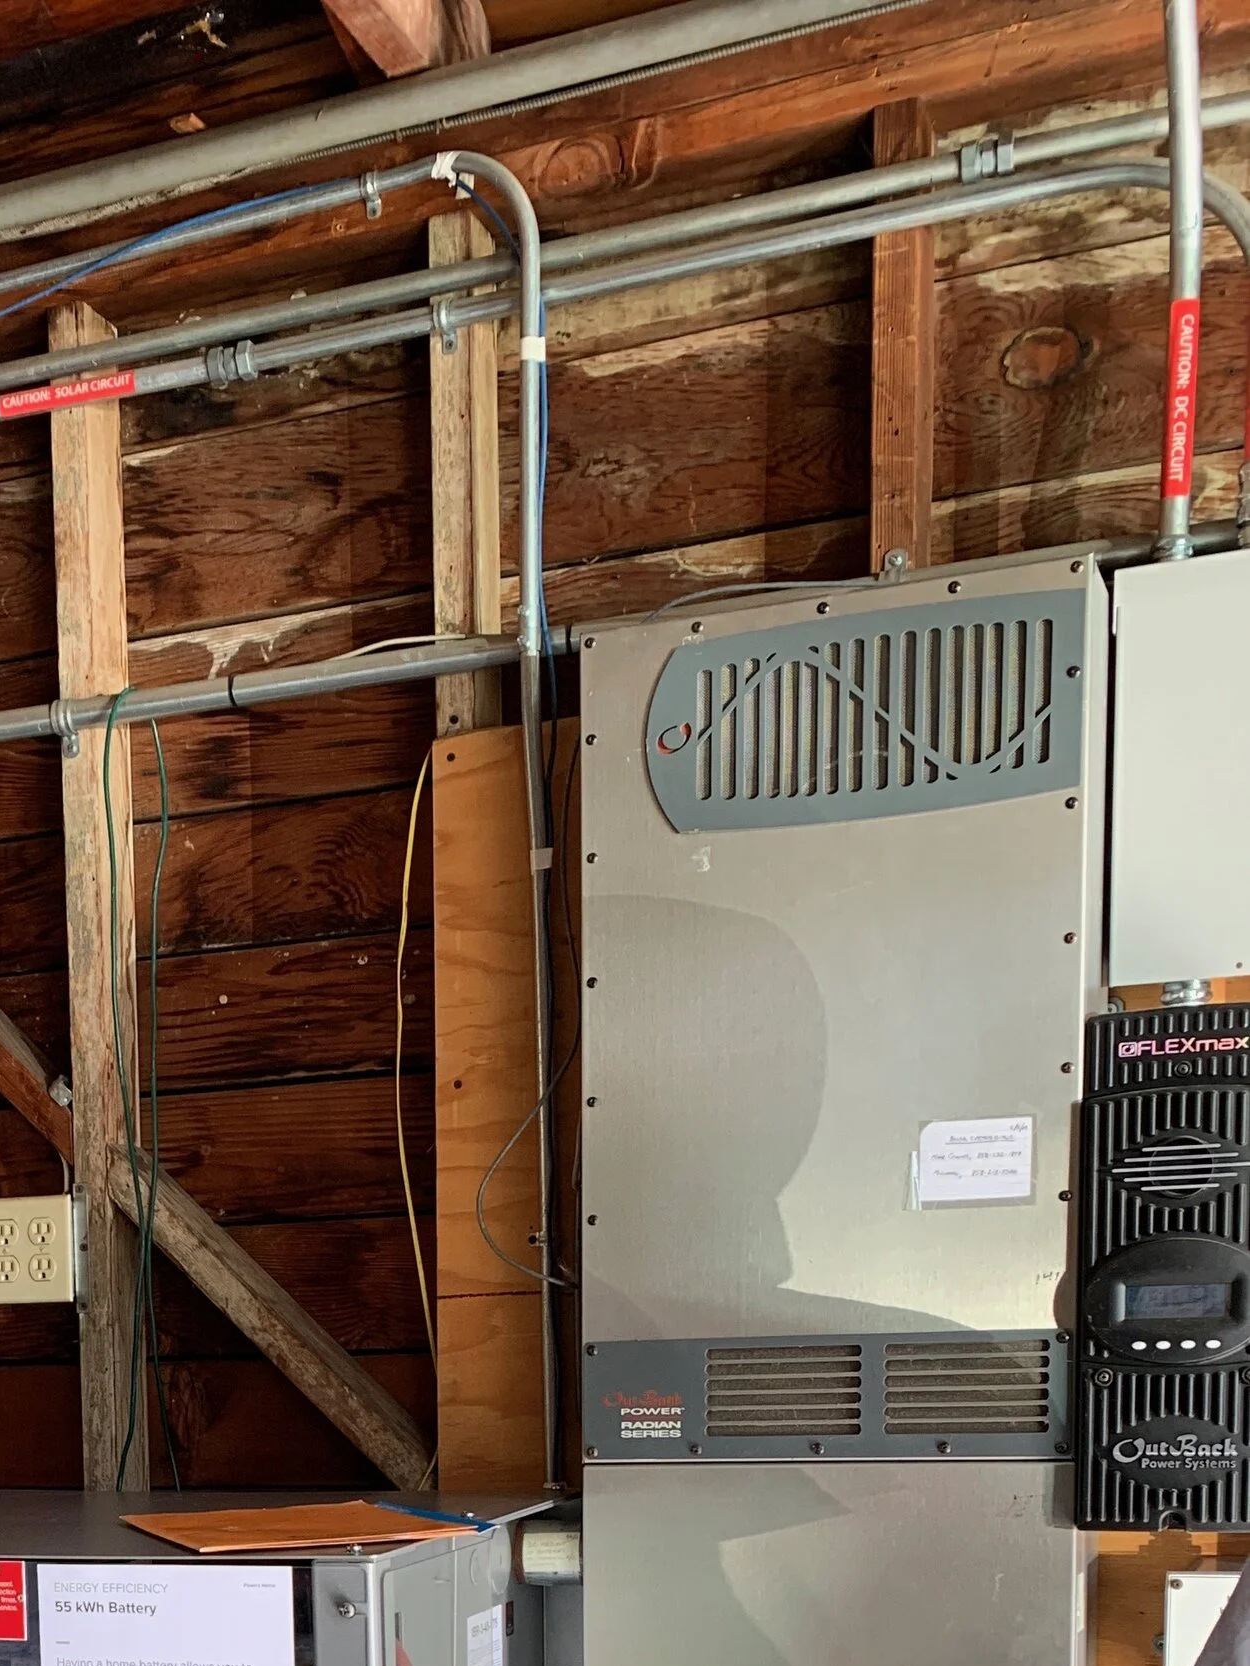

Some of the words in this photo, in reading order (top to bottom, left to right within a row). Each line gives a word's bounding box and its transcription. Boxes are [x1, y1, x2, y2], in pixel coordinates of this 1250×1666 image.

[1177, 314, 1195, 390] CAUTION:
[2, 390, 51, 409] CAUTION:
[54, 382, 89, 399] SOLAR
[89, 373, 132, 392] CIRCUIT
[1174, 395, 1190, 419] DC
[1169, 422, 1187, 482] CIRCUIT
[1137, 1036, 1250, 1056] FLEXmax
[601, 1389, 683, 1408] OutBack
[620, 1407, 682, 1416] POWER
[620, 1421, 682, 1429] RADIAN
[620, 1429, 682, 1438] SERIES
[1112, 1434, 1239, 1463] OutBack
[1141, 1458, 1182, 1469] Power
[1185, 1458, 1237, 1471] Systems
[53, 1582, 99, 1593] ENERGY
[102, 1583, 168, 1594] EFFICIENCY
[55, 1601, 72, 1613] 55
[76, 1601, 104, 1613] kWh
[109, 1602, 157, 1617] Battery
